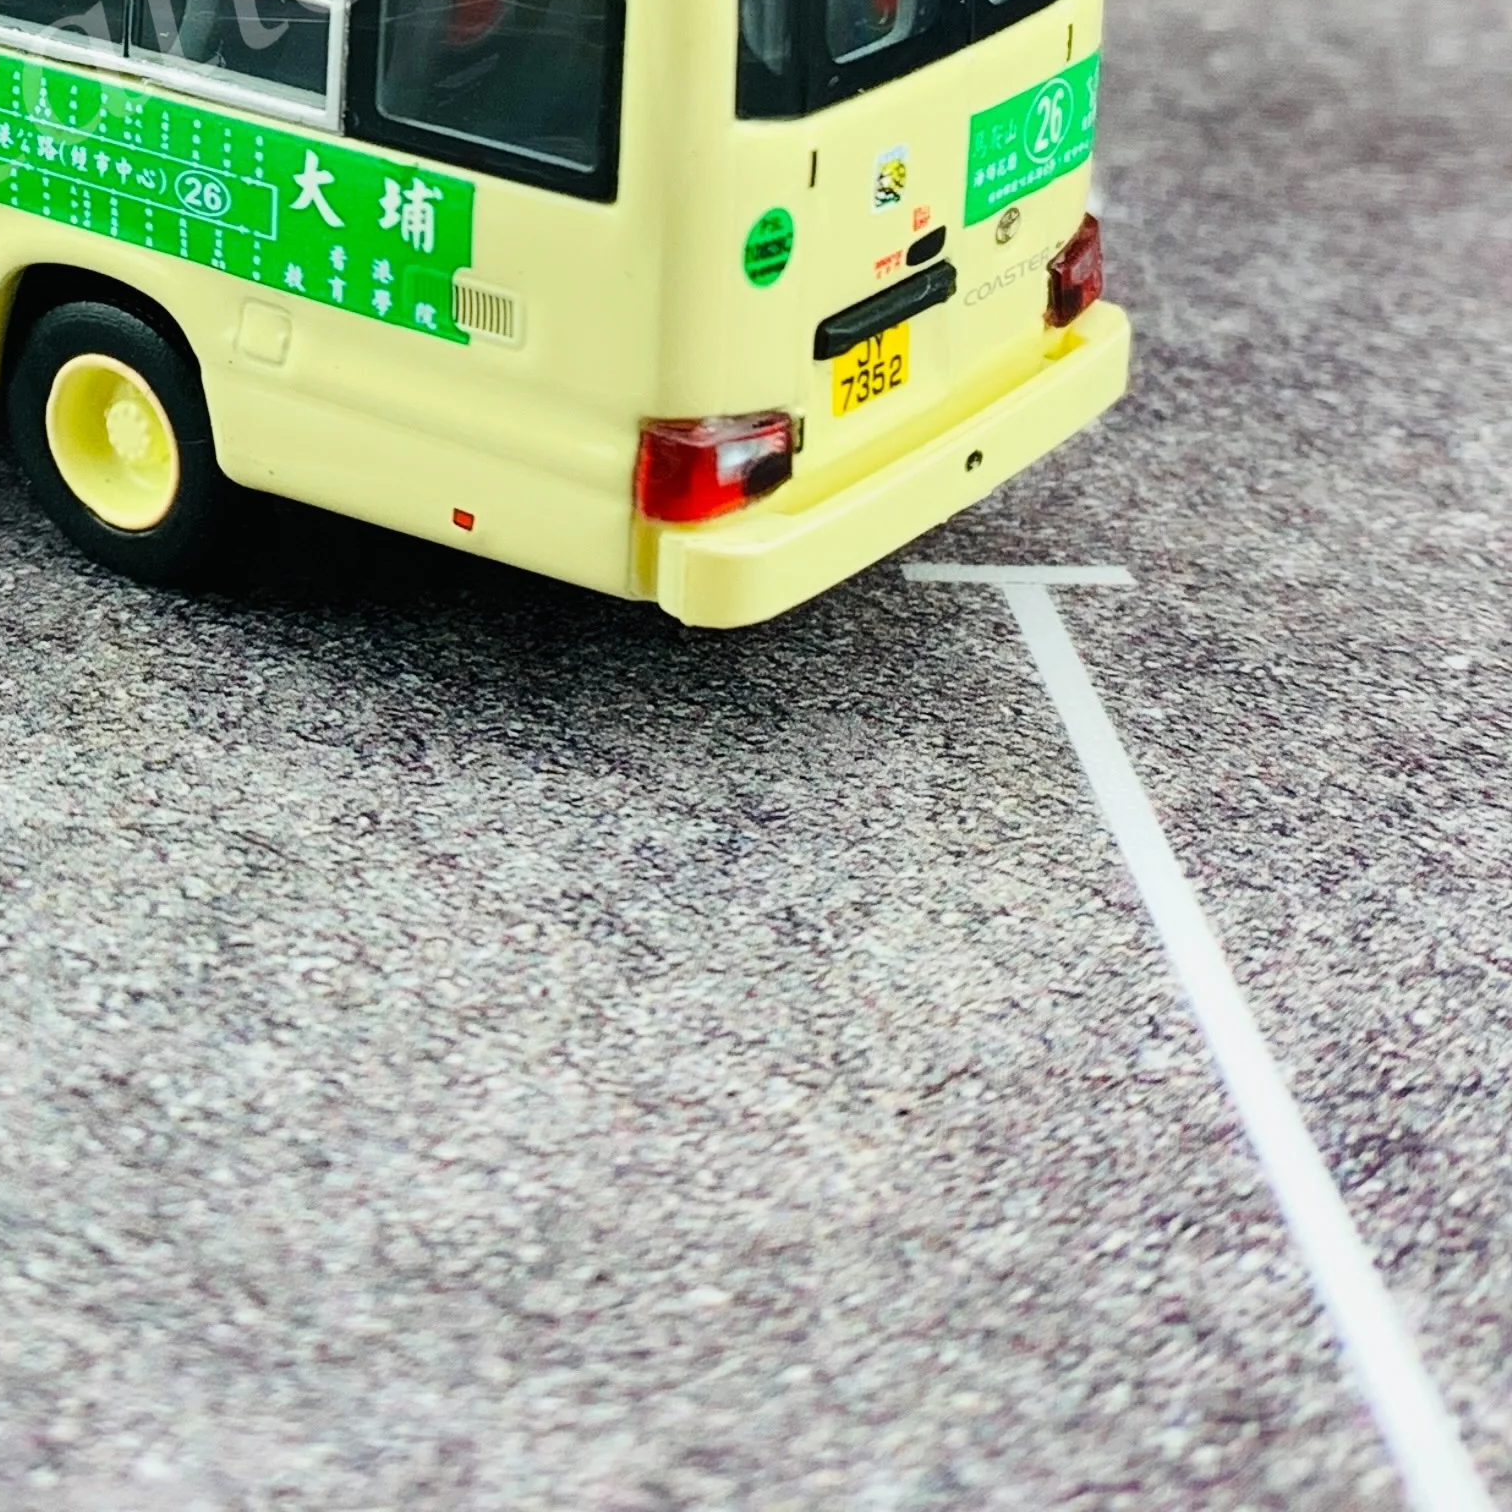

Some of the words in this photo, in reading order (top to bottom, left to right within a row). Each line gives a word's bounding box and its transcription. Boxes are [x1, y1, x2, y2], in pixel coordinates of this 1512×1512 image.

[1033, 88, 1065, 154] 26
[184, 177, 223, 211] 26
[289, 148, 444, 254] 大埔
[963, 247, 1050, 308] COASTER
[840, 354, 903, 412] 7352
